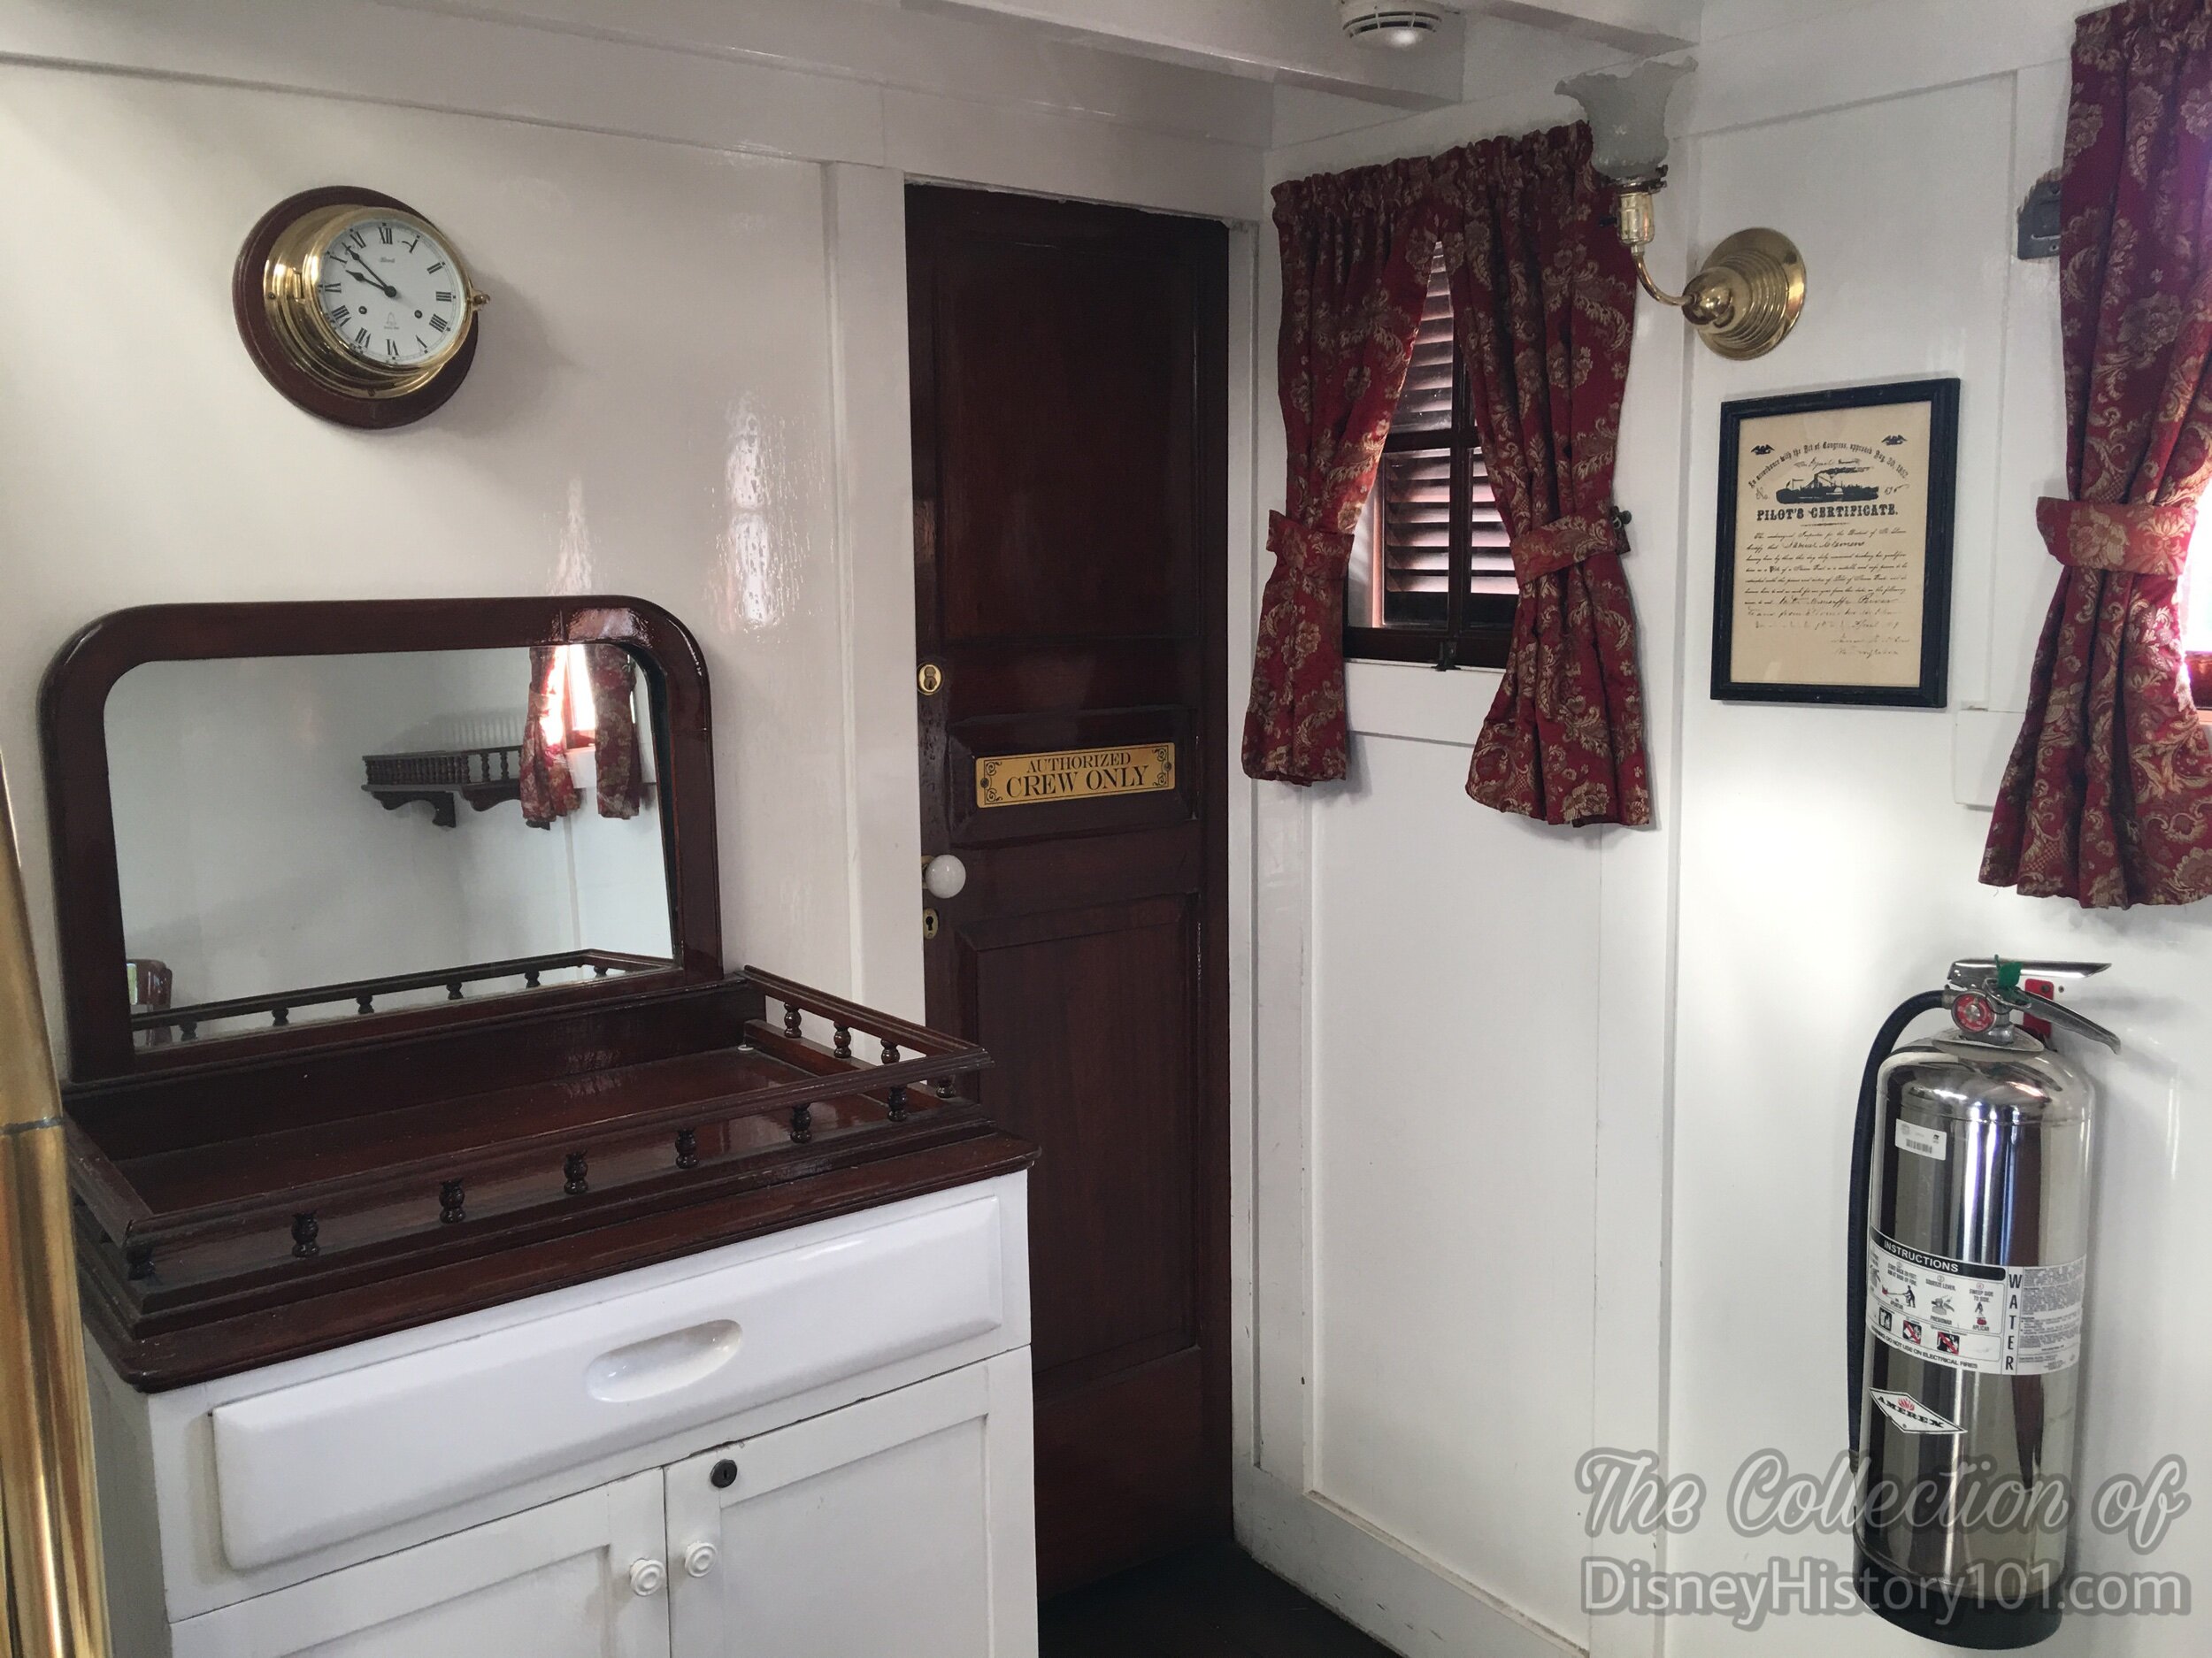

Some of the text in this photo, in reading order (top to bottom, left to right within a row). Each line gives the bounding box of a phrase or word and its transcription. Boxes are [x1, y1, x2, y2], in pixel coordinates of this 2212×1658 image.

[1793, 448, 1801, 457] the
[1756, 503, 1899, 521] PILOT'S CERTIFICATE.
[1026, 752, 1131, 773] AUTHORIZED
[1005, 764, 1149, 798] CREW ONLY
[1884, 1240, 1959, 1273] INSTRUCTIONS
[2004, 1273, 2023, 1371] WATER
[1902, 1344, 1913, 1353] USE
[1922, 1352, 1958, 1366] ELECTRICAL
[1878, 1396, 1945, 1429] AMEREX
